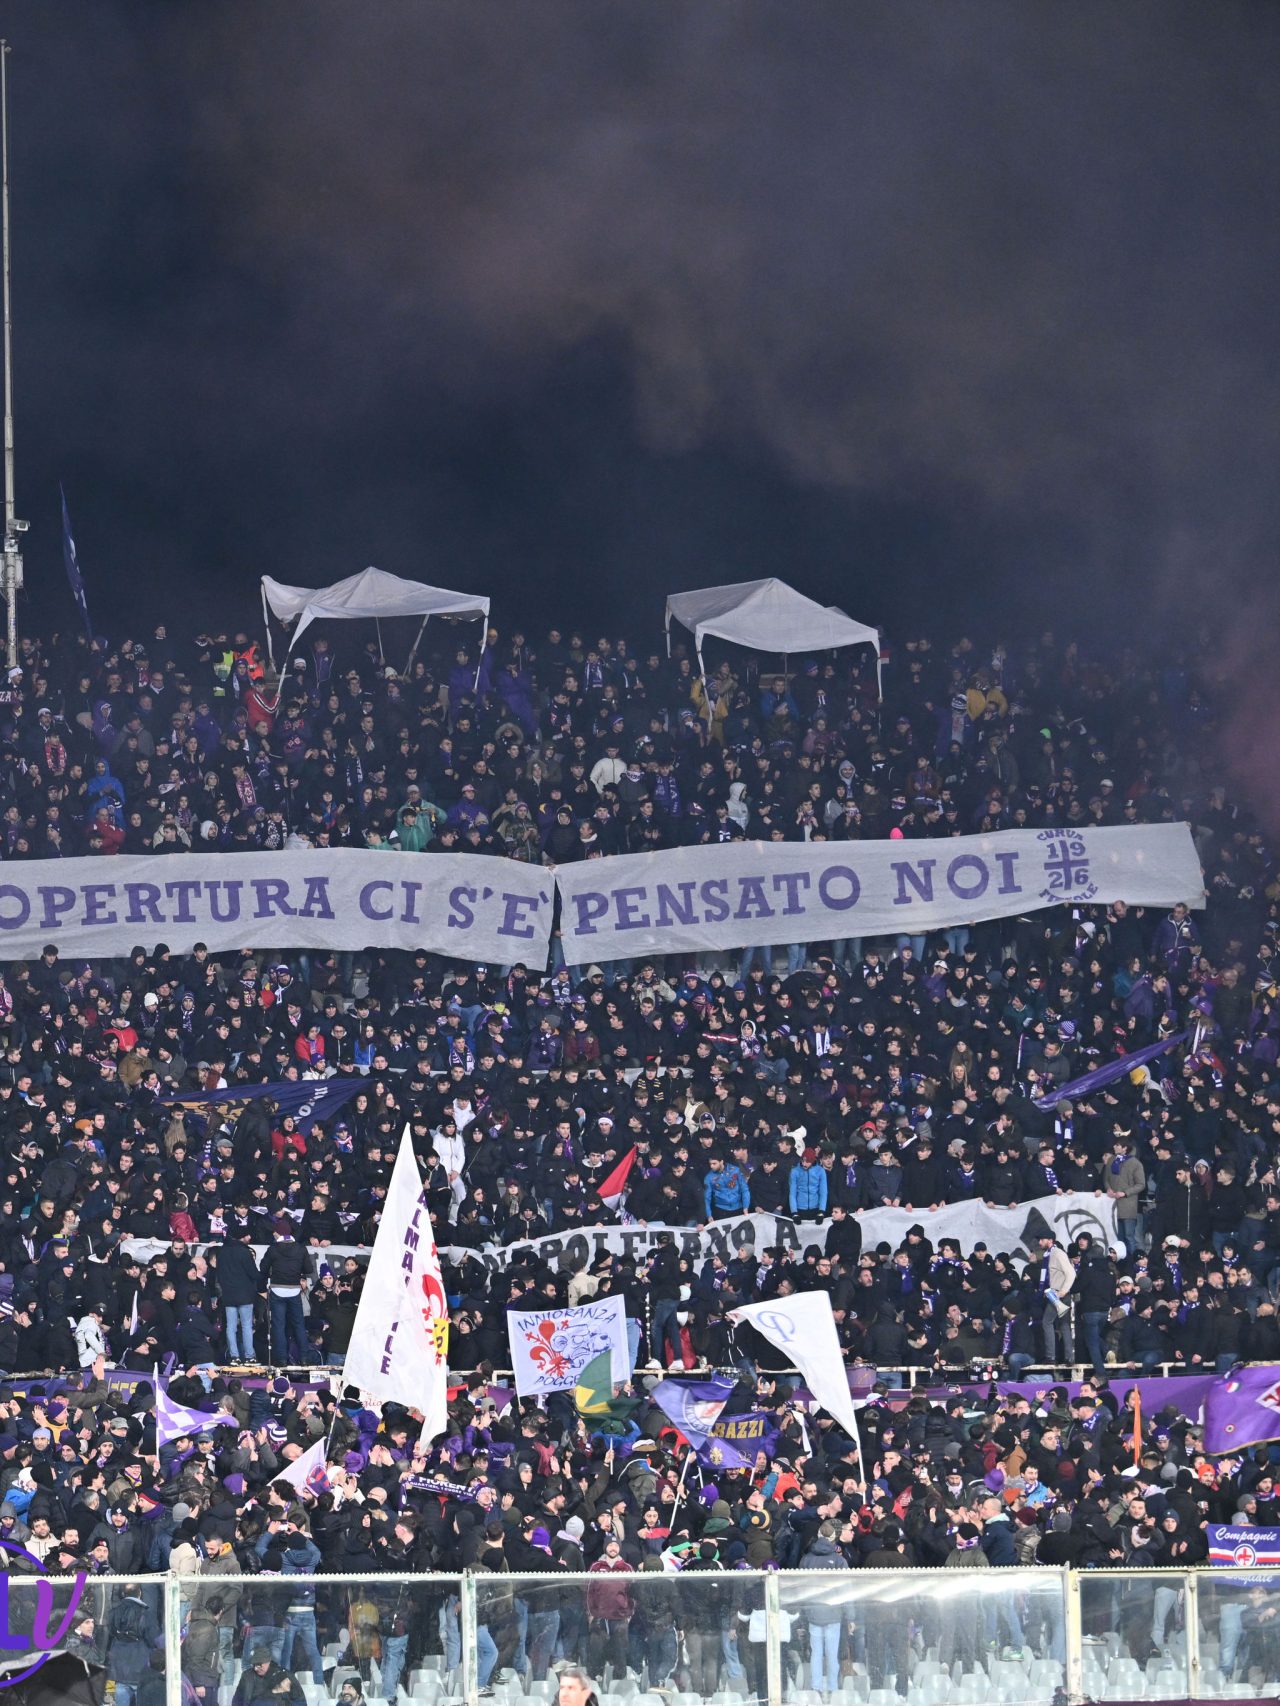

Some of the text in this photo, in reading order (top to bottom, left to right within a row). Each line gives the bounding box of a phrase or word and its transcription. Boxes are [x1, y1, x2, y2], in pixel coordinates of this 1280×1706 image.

[1037, 828, 1083, 841] CURVA
[359, 878, 422, 923] CI
[572, 865, 862, 935] PENSATO
[890, 851, 1023, 905] NOI
[1215, 1527, 1278, 1544] Compagnie
